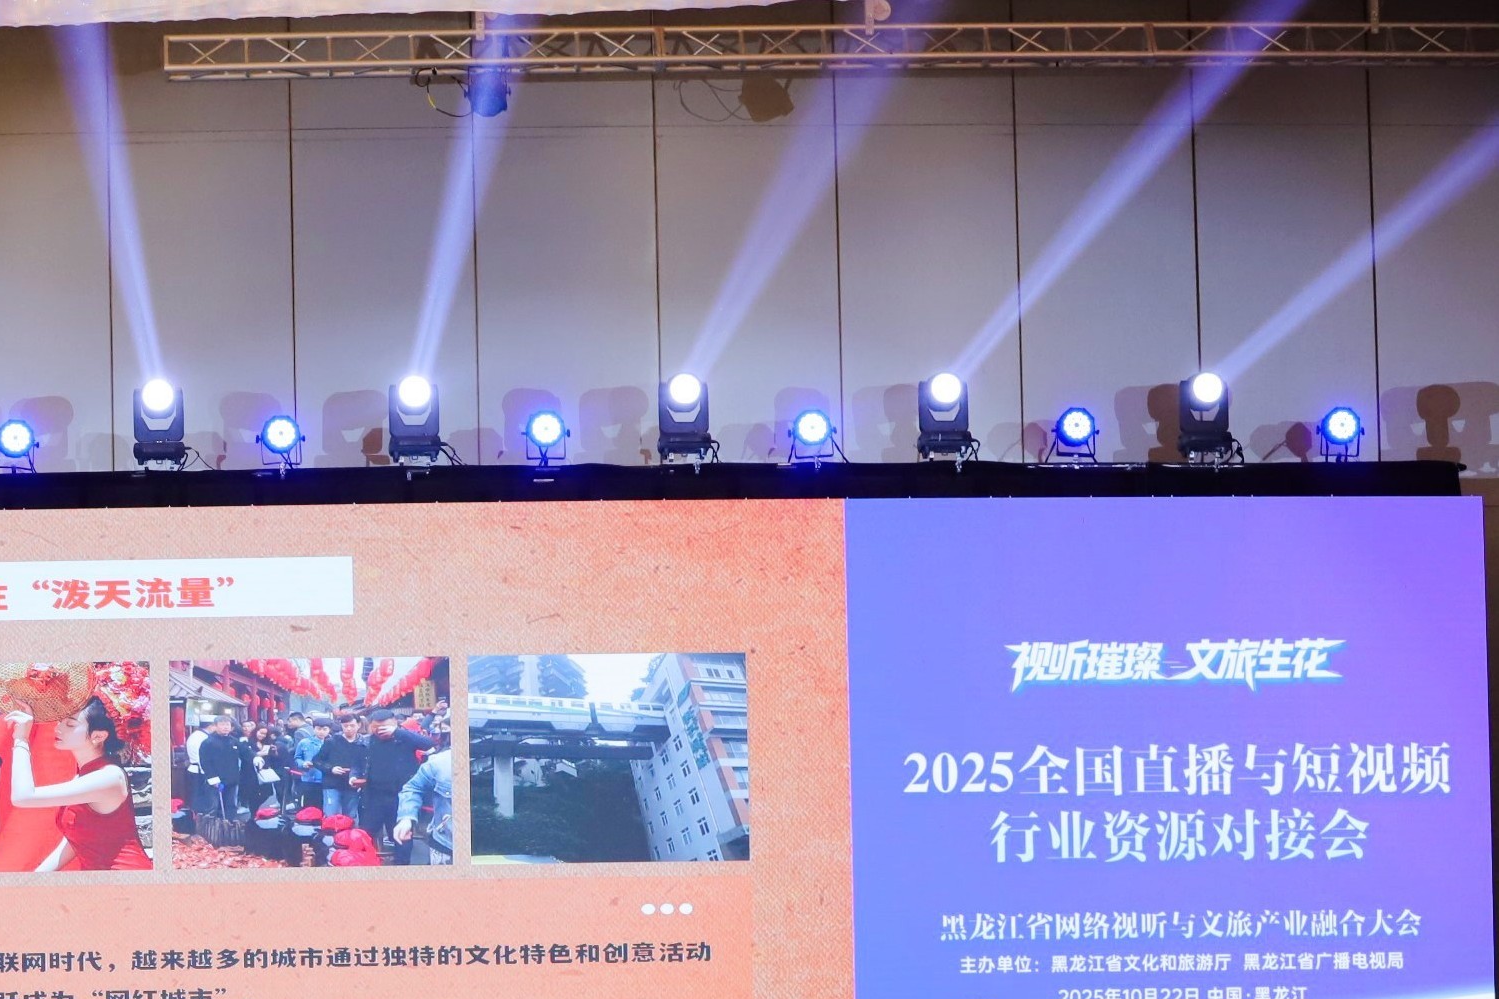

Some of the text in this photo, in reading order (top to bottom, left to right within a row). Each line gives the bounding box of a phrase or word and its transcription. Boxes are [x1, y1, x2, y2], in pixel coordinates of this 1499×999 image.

[1005, 638, 1347, 692] 视听璀璨 文旅生花
[903, 741, 1452, 797] 2025全国直播与短视频
[990, 807, 1370, 864] 行业资源对接会
[939, 909, 1422, 944] 黑龙江省网络视听与文旅产业融合大会
[959, 952, 1404, 975] 主办单位：黑龙江省文化和旅游厅 黑龙江省广播电视局
